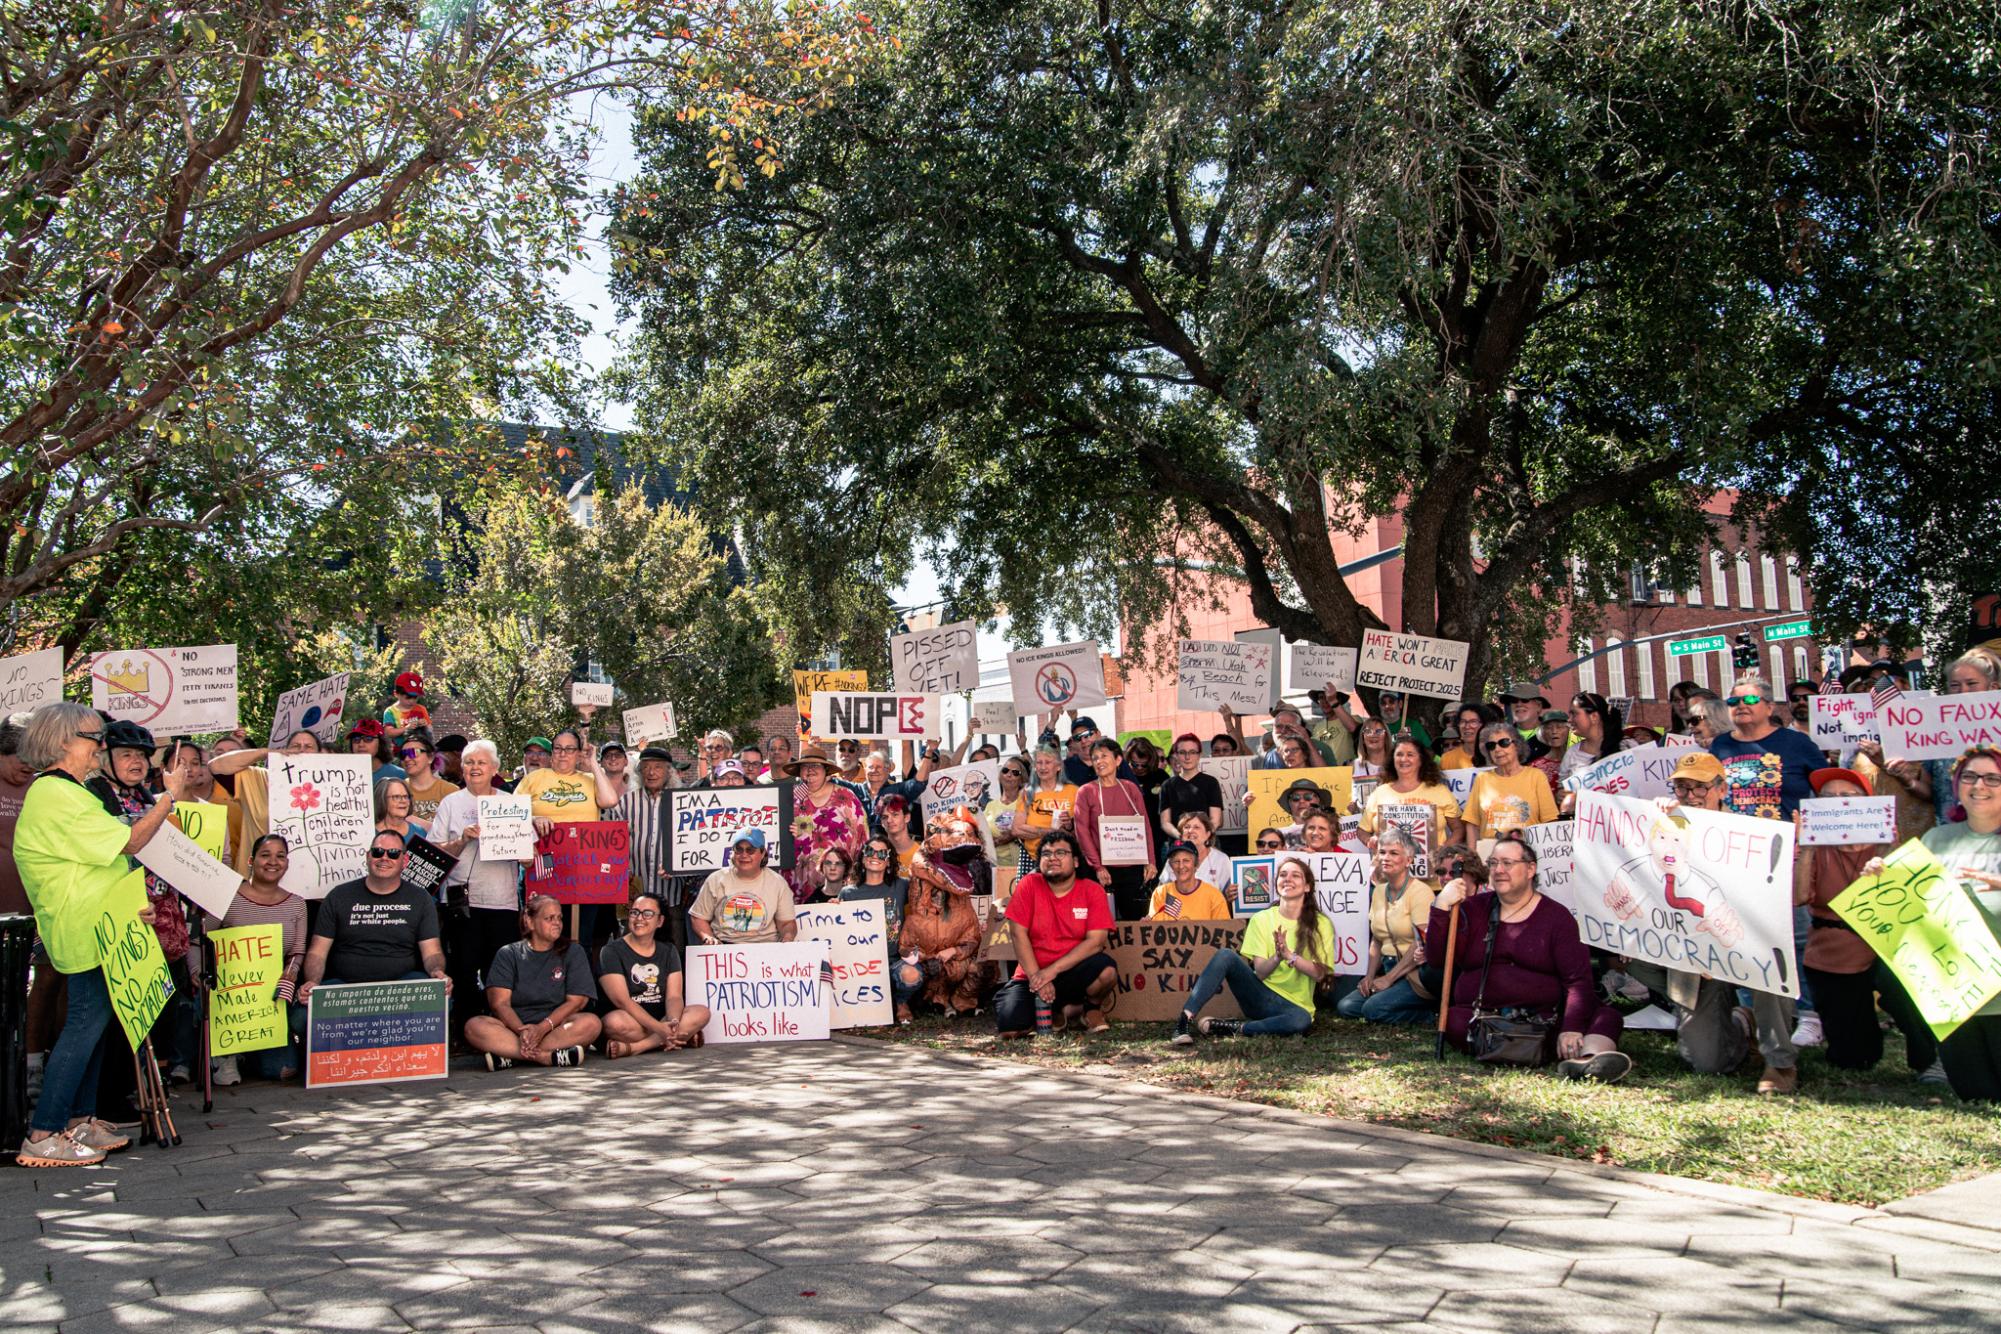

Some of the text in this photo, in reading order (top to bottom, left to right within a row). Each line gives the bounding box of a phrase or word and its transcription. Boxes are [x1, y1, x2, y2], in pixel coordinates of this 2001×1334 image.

[1777, 627, 1797, 636] Main
[1800, 624, 1809, 632] St
[903, 630, 973, 664] PISSED
[1366, 633, 1393, 648] HATE
[1692, 641, 1710, 649] Main
[1713, 639, 1722, 647] St
[182, 651, 198, 661] NO
[1026, 654, 1035, 662] ICE
[1036, 652, 1054, 660] KINGS
[1222, 643, 1247, 656] NOT
[909, 655, 951, 681] OFF
[1326, 657, 1335, 666] be
[1421, 655, 1457, 672] GREAT
[6, 666, 28, 684] NO
[910, 670, 961, 693] YET!
[1202, 671, 1244, 684] Beach
[1360, 671, 1461, 695] REJECT PROJECT 2025
[280, 672, 350, 713] SAME HATE
[576, 688, 586, 696] NO
[587, 695, 608, 704] KINGS
[1190, 685, 1263, 704] This Mess!
[108, 696, 150, 711] KINGS
[830, 697, 925, 735] NOPE
[1887, 701, 2001, 726] NO FAUX
[1905, 731, 1953, 749] KING
[331, 783, 368, 797] is not
[1732, 788, 1781, 797] PROTECT
[326, 797, 370, 818] healthy
[677, 793, 721, 811] I'M A
[927, 796, 966, 810] NO KINGS
[1043, 800, 1071, 811] LOVE
[1733, 796, 1782, 805] DEMOCRACY
[481, 800, 529, 820] Protesting
[1811, 803, 1883, 819] Immigrants Are
[273, 814, 363, 835] for children
[509, 824, 521, 832] my
[1811, 821, 1884, 833] Welcome Here!
[315, 829, 357, 841] other
[579, 828, 627, 851] KINGS
[677, 834, 688, 844] I
[700, 831, 720, 844] DO
[1543, 826, 1553, 843] A
[1577, 801, 1783, 884] HANDS OFF!
[491, 846, 518, 855] future
[681, 850, 713, 868] FOR
[411, 853, 446, 878] YOU AREN'T
[414, 873, 433, 888] WHAT
[352, 903, 411, 912] due process:
[1245, 895, 1269, 904] RESIST
[1859, 876, 1925, 925] YOU
[375, 912, 389, 920] just
[795, 908, 873, 930] Time to
[1652, 907, 1688, 936] OUR
[94, 911, 117, 960] NO
[847, 934, 879, 946] our
[1140, 925, 1244, 950] FOUNDERS
[215, 935, 272, 965] HATE
[1585, 915, 1789, 994] DEMOCRACY!
[697, 951, 814, 980] THIS is what
[216, 970, 264, 987] Never
[1117, 973, 1146, 994] NO
[339, 989, 371, 998] importa
[415, 985, 434, 993] eres,
[705, 979, 817, 1010] PATRIOTISM
[117, 978, 142, 1024] NO
[216, 991, 257, 1011] Made
[323, 999, 357, 1008] estamos
[360, 997, 399, 1005] contentos
[401, 995, 416, 1004] que
[348, 1003, 410, 1014] nuestro vecino.
[215, 1006, 279, 1029] AMERICA
[317, 1023, 331, 1031] No
[335, 1021, 367, 1029] matter
[372, 1019, 400, 1027] where
[405, 1018, 422, 1027] you
[722, 1002, 799, 1037] looks like
[219, 1026, 275, 1048] GREAT
[321, 1031, 347, 1039] from,
[381, 1026, 403, 1037] glad
[406, 1024, 436, 1035] you're
[367, 1034, 413, 1044] neighbor.
[431, 1046, 440, 1056] لا
